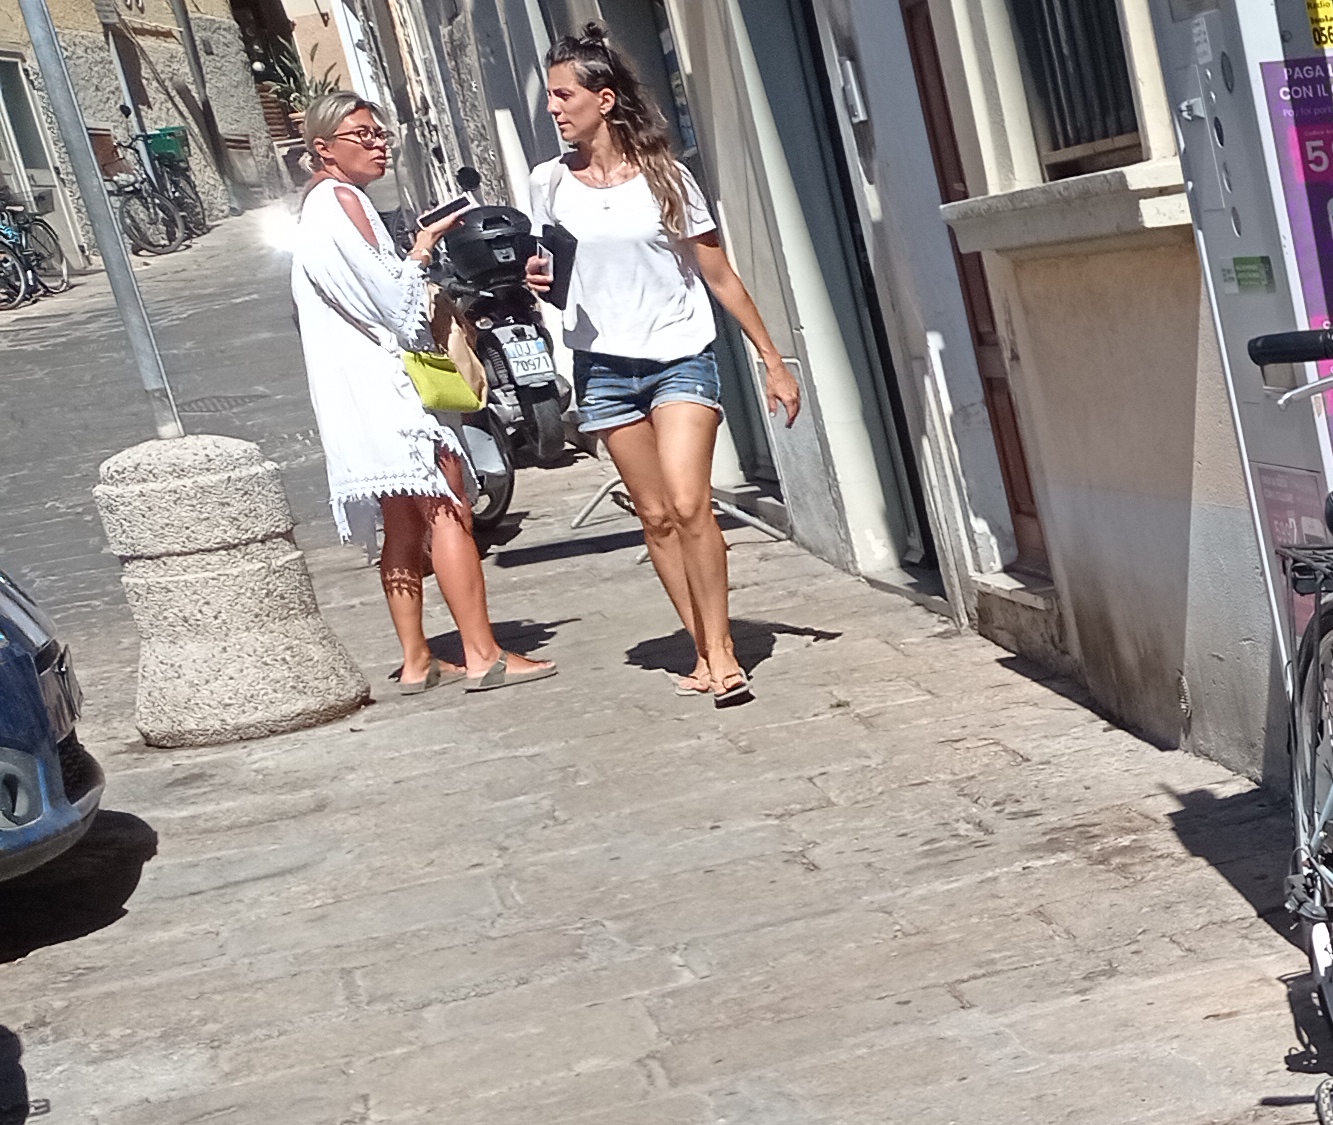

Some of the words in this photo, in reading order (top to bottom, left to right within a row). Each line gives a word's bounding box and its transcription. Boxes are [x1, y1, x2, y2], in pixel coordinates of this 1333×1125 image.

[1284, 65, 1325, 80] PAGA
[1279, 83, 1314, 101] CON
[1317, 85, 1329, 97] IL
[513, 355, 550, 373] 70971
